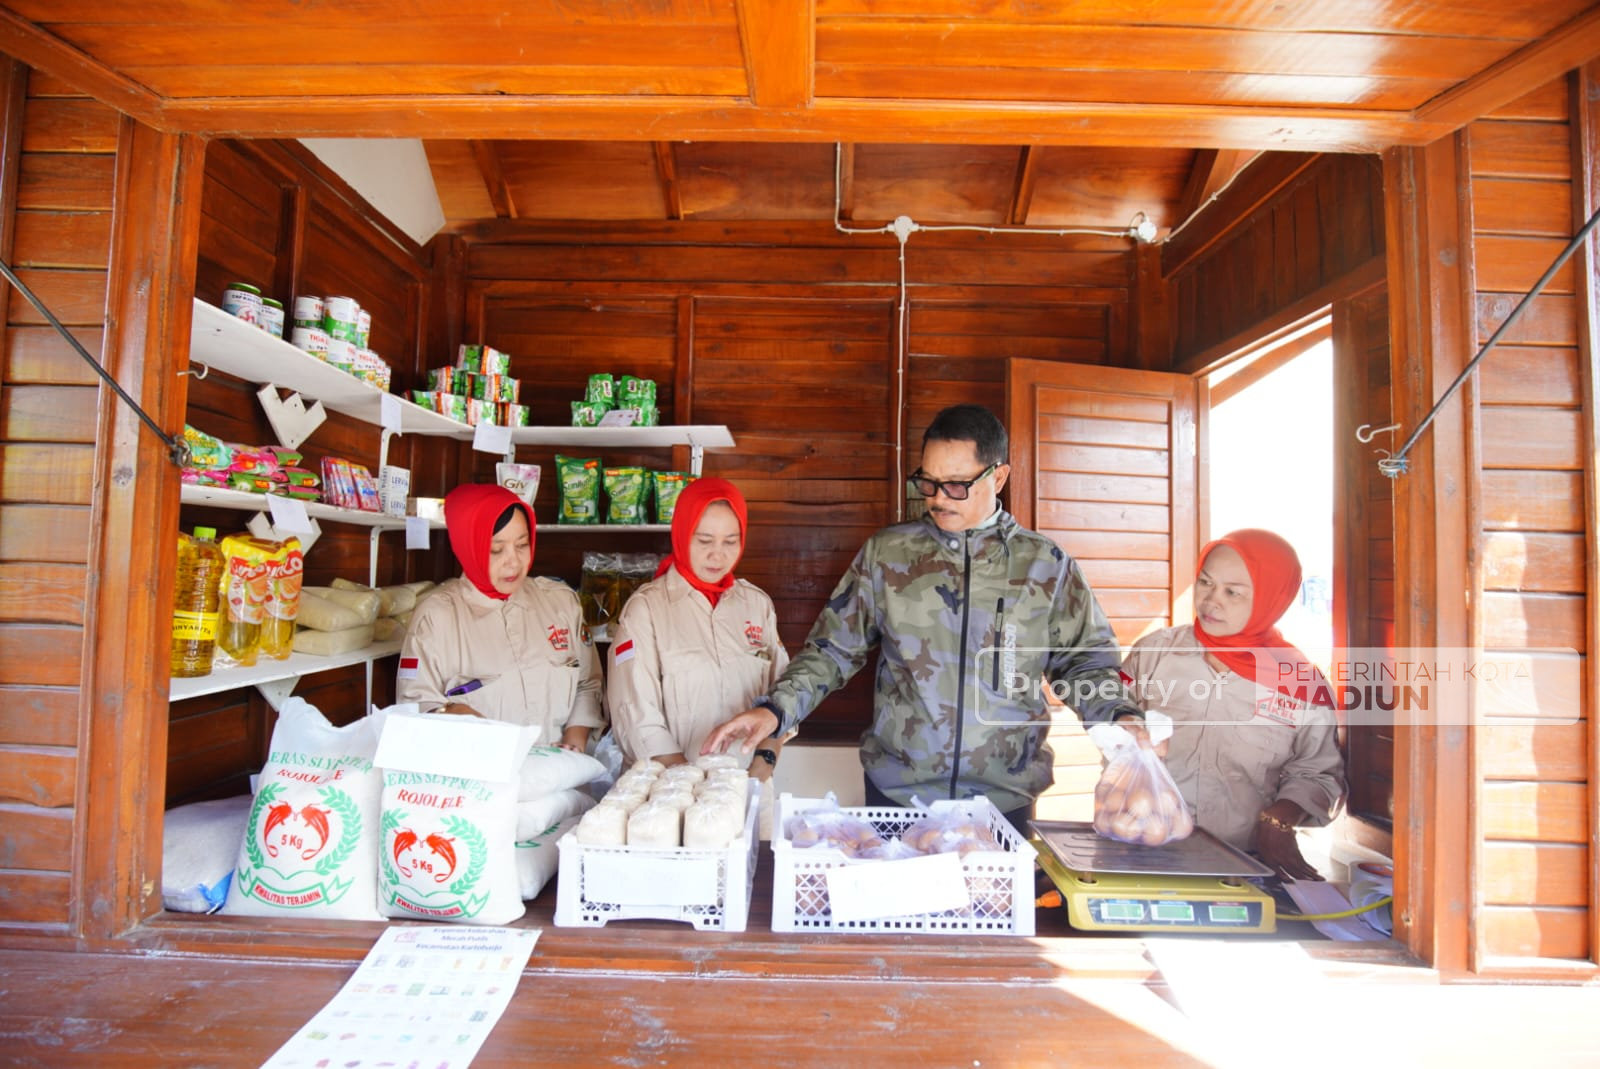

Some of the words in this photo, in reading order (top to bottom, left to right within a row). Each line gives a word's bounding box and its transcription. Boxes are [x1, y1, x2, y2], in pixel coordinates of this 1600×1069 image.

[270, 751, 306, 764] ERAS
[383, 772, 422, 787] ERAS
[281, 834, 287, 845] 5
[289, 834, 303, 850] Kg
[412, 858, 418, 869] 5
[420, 860, 433, 874] Kg
[255, 884, 286, 905] KWALITAS
